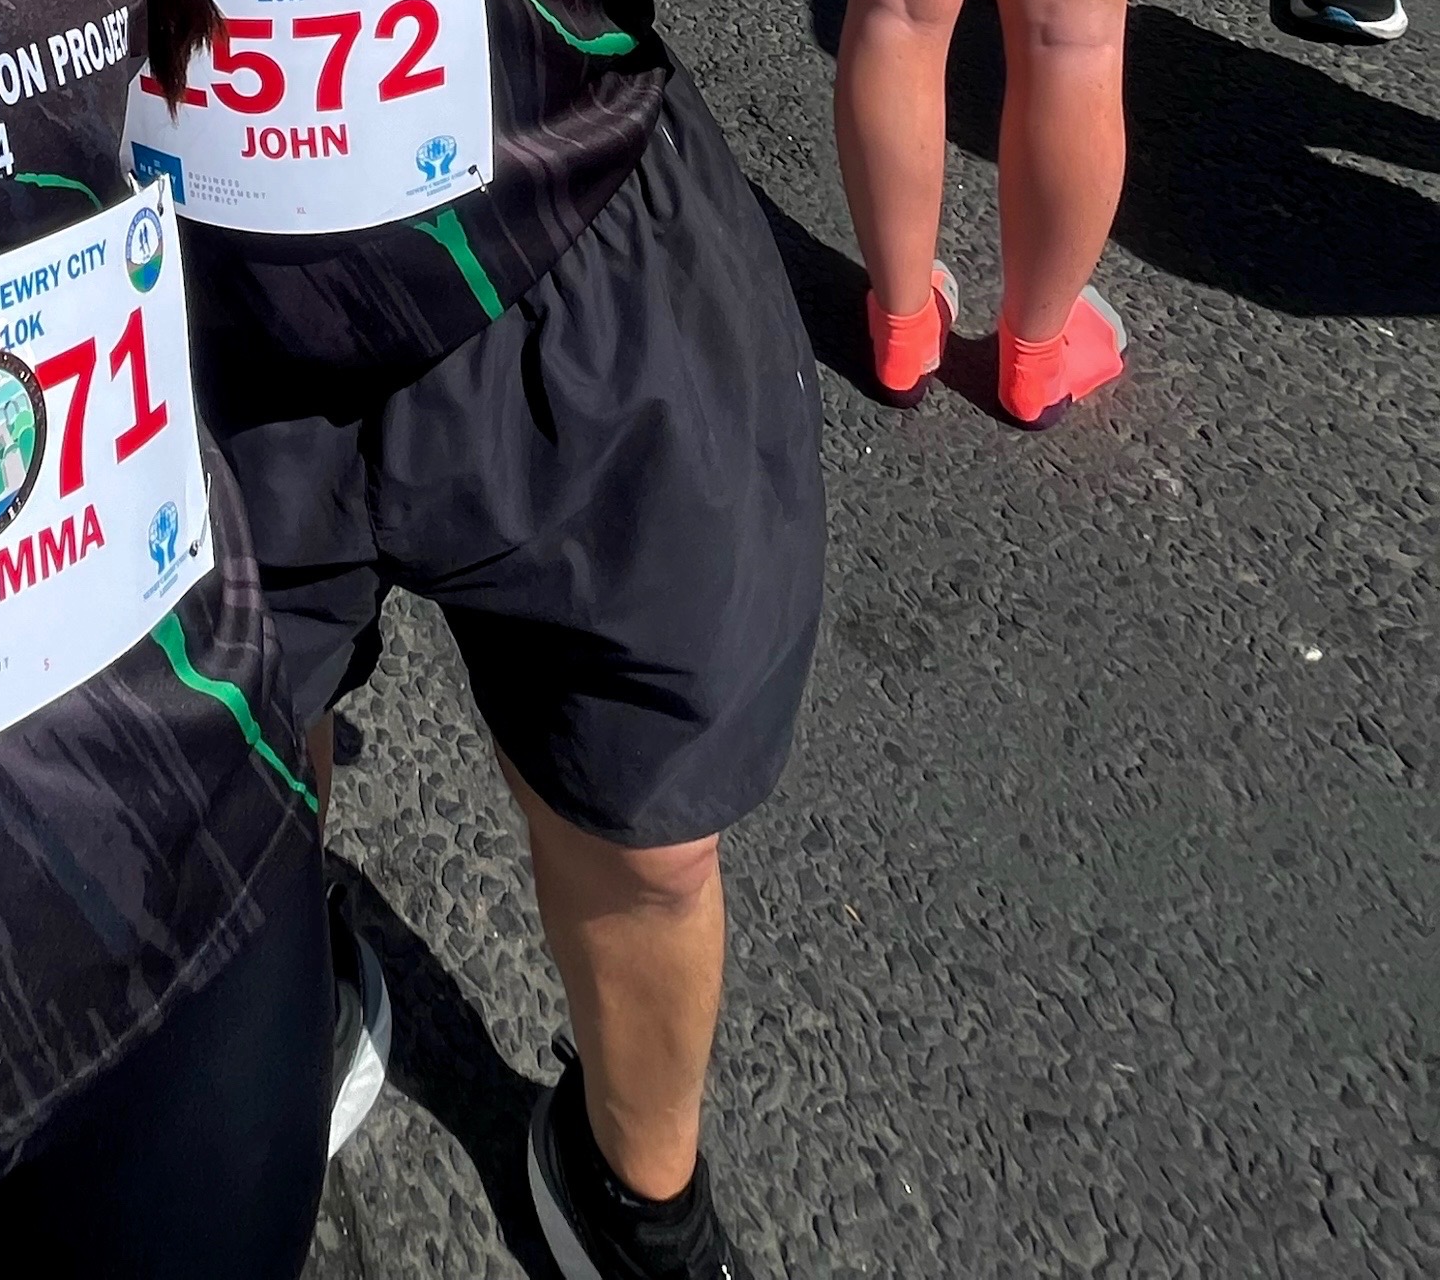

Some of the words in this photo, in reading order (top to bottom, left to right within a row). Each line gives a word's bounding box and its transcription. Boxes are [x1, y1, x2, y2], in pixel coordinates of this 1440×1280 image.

[47, 5, 129, 87] PROJECT
[240, 122, 350, 161] JOHN
[188, 171, 241, 189] BUSINESS
[66, 238, 108, 280] CITY
[0, 310, 45, 350] 10K
